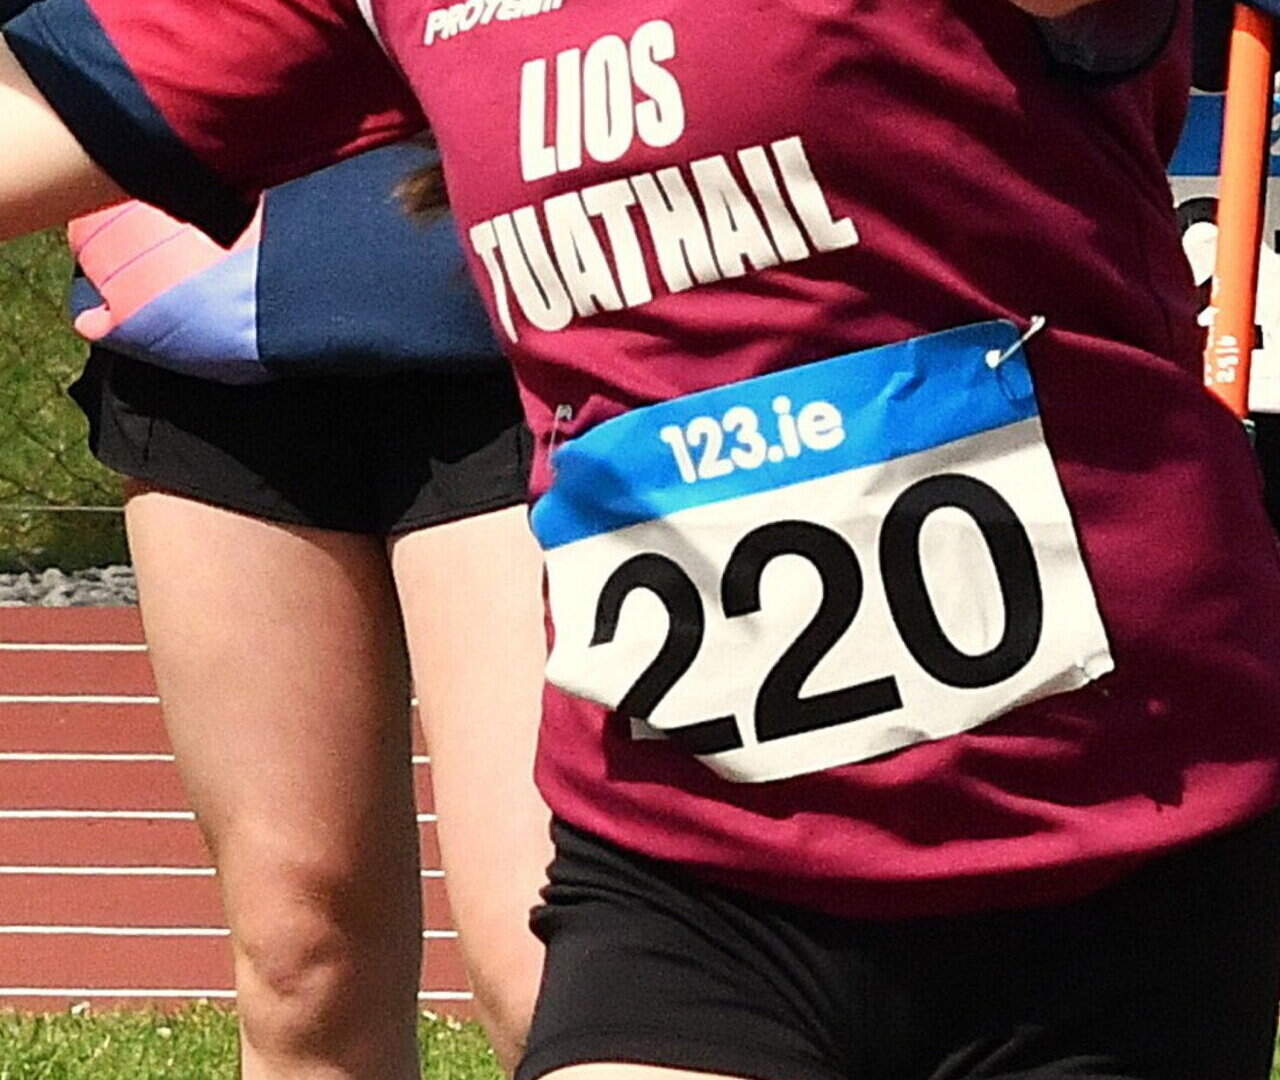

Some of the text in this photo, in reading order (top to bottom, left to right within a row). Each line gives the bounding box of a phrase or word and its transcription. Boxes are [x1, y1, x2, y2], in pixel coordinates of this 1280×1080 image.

[521, 20, 685, 182] LIOS
[469, 136, 860, 344] TUATHAIL
[660, 395, 846, 484] 123.ie
[589, 472, 1044, 756] 220
